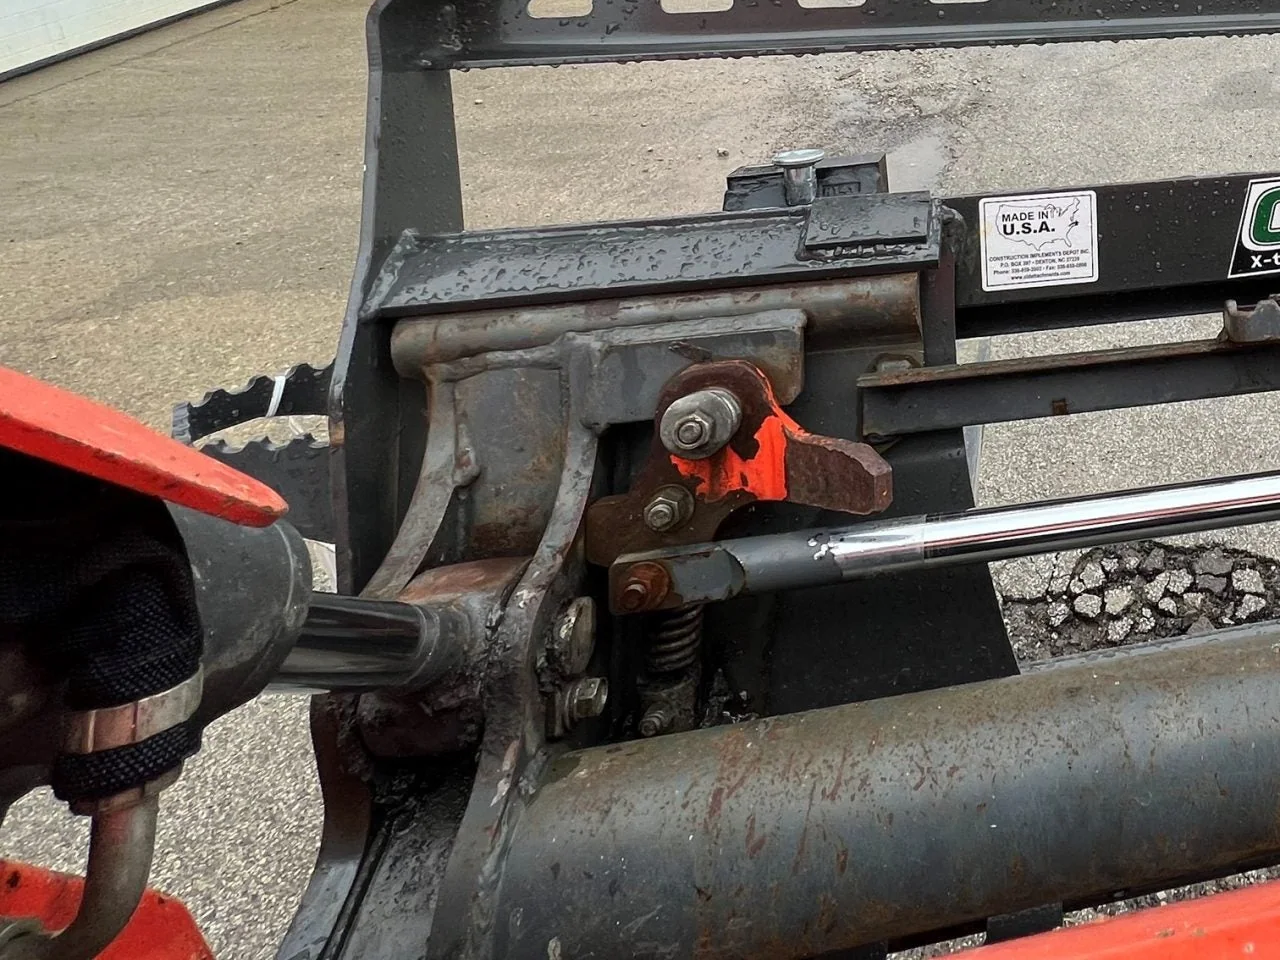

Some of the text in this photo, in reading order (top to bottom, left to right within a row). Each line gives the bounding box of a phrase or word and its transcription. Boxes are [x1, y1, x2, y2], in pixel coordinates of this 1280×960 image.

[1002, 210, 1049, 223] MADE IN
[1003, 221, 1056, 236] U.S.A.
[989, 254, 1029, 262] CONSTRUCTION
